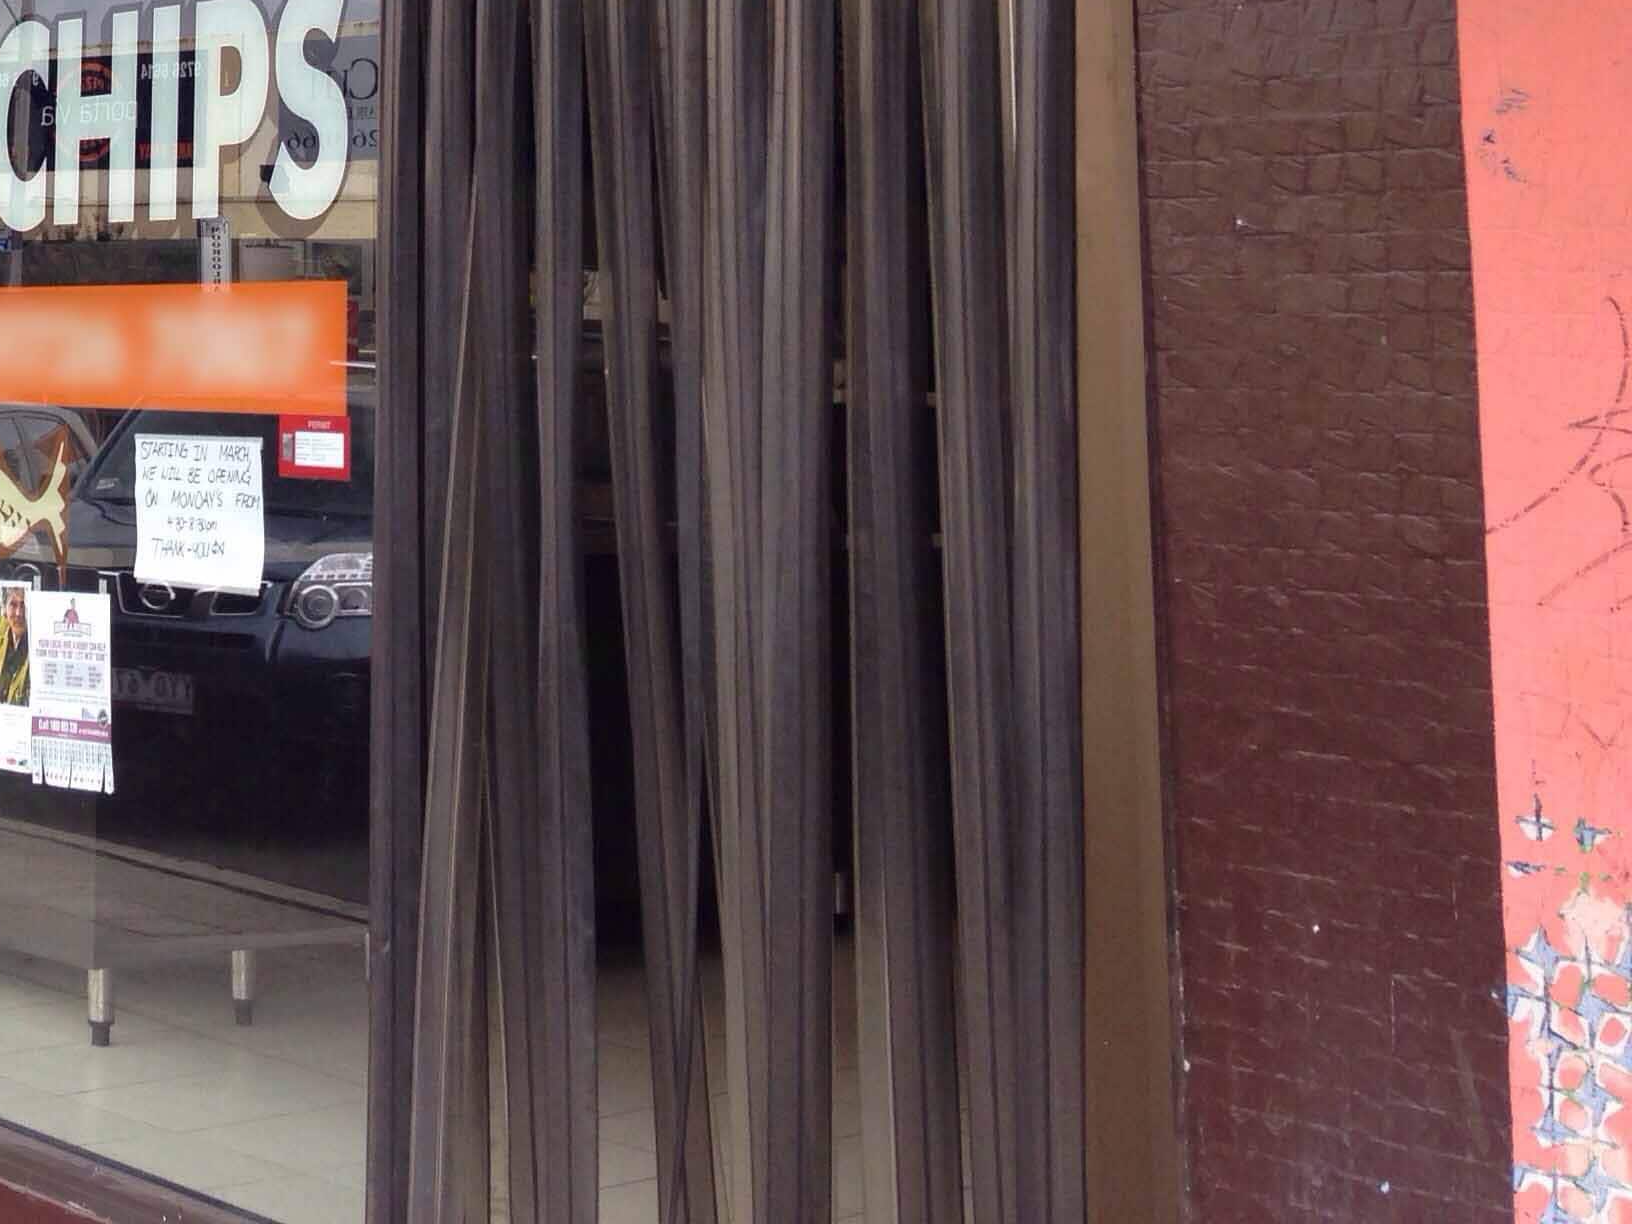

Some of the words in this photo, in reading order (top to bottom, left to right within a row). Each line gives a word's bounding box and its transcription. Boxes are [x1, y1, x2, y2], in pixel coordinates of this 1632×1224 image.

[140, 441, 189, 460] STARTING
[193, 444, 208, 462] IN
[188, 466, 202, 484] BE
[145, 487, 159, 508] ON
[235, 492, 261, 510] FROM
